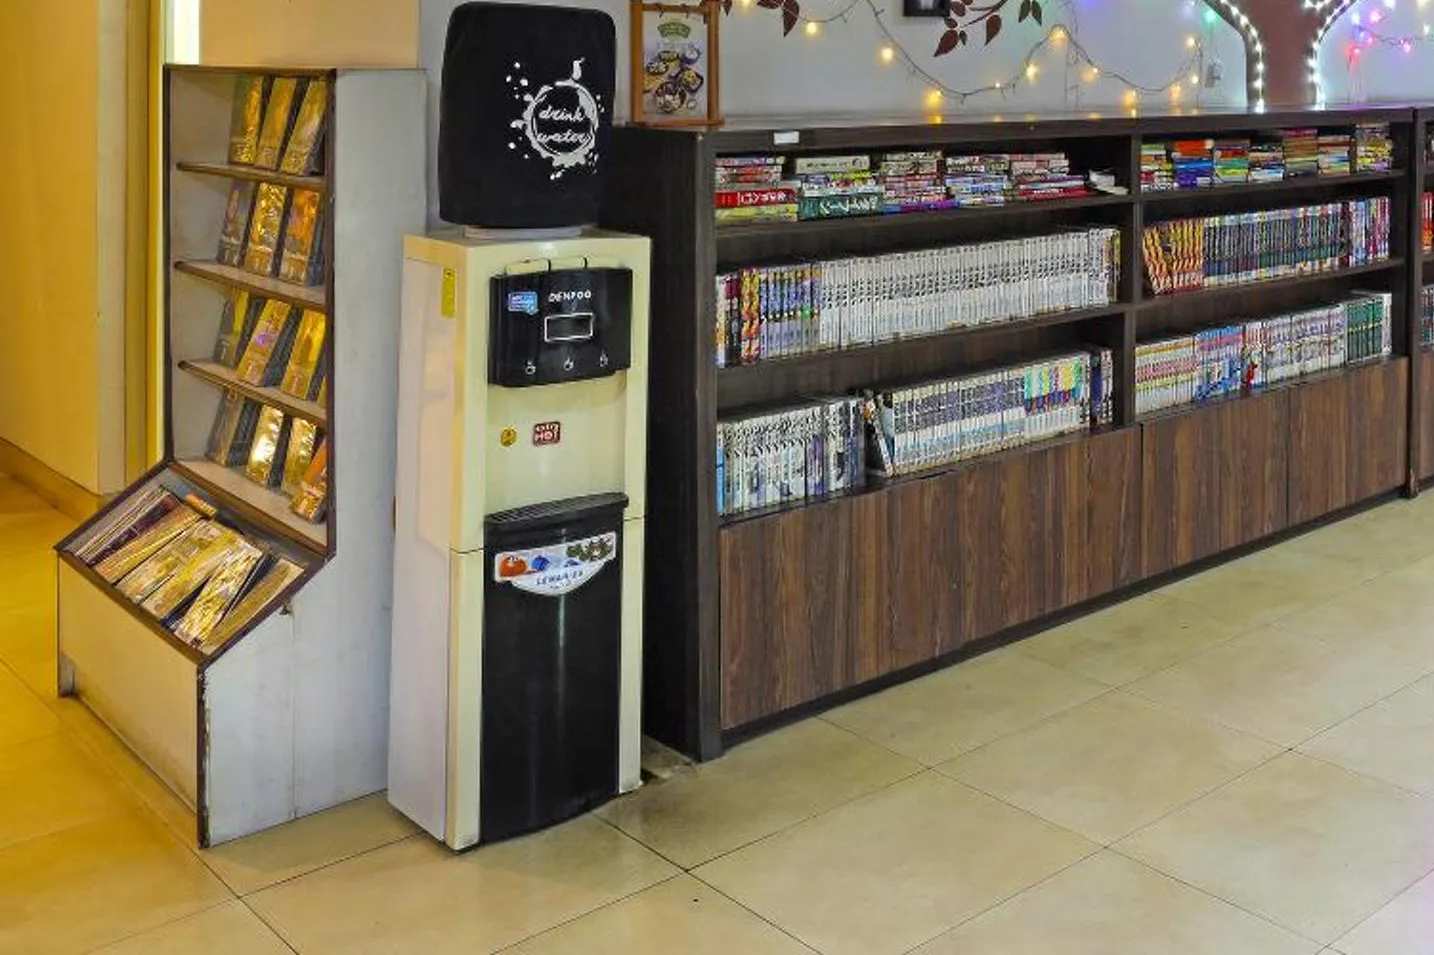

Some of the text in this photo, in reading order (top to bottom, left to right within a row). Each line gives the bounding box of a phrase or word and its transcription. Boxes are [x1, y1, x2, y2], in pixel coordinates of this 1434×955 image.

[539, 105, 584, 121] drink
[548, 290, 592, 302] DENPOO
[535, 430, 559, 441] HOT
